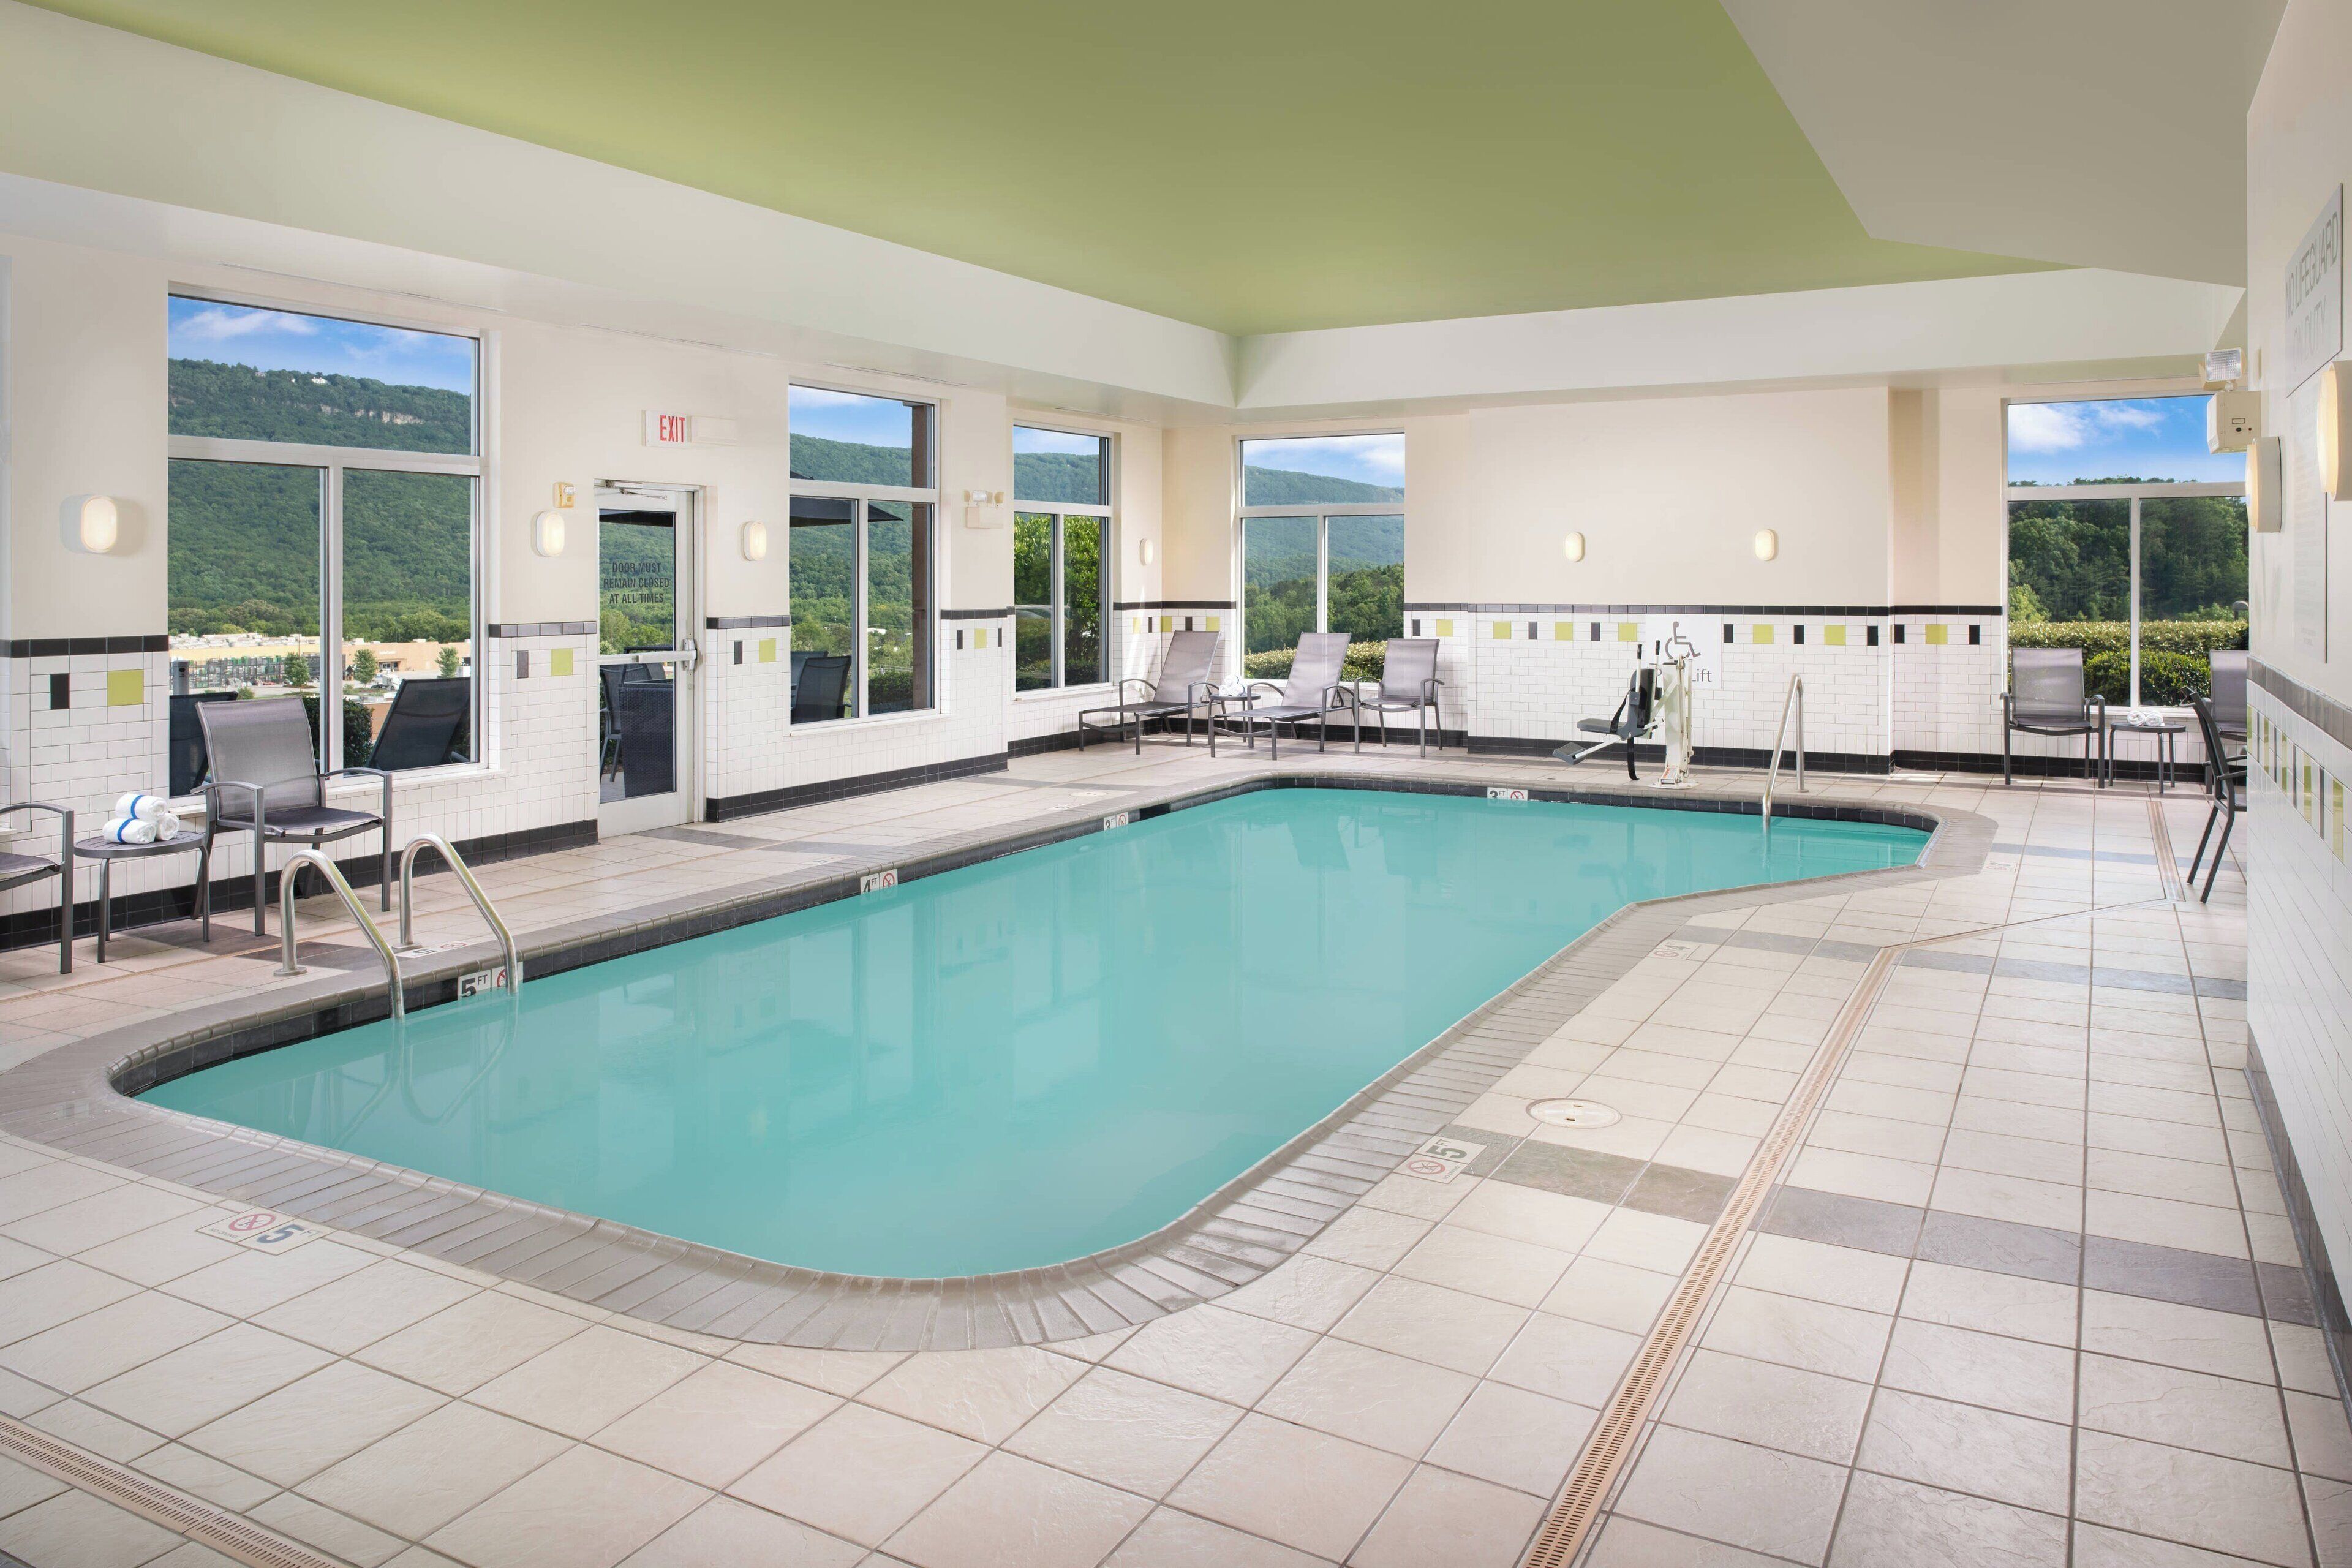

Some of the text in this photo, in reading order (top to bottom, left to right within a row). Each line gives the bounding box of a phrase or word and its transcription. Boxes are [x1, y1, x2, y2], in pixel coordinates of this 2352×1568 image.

[2285, 212, 2339, 321] NO LIFEGUARD
[2304, 295, 2327, 362] DUTY
[660, 415, 685, 442] EXIT
[612, 562, 662, 573] DOOR MUST
[603, 578, 669, 588] REMAIN CLOSED
[609, 593, 664, 604] AT ALL TIMES
[871, 877, 877, 886] FT
[461, 974, 488, 998] 5 FT
[1426, 1145, 1468, 1159] 5
[256, 1224, 305, 1244] 5
